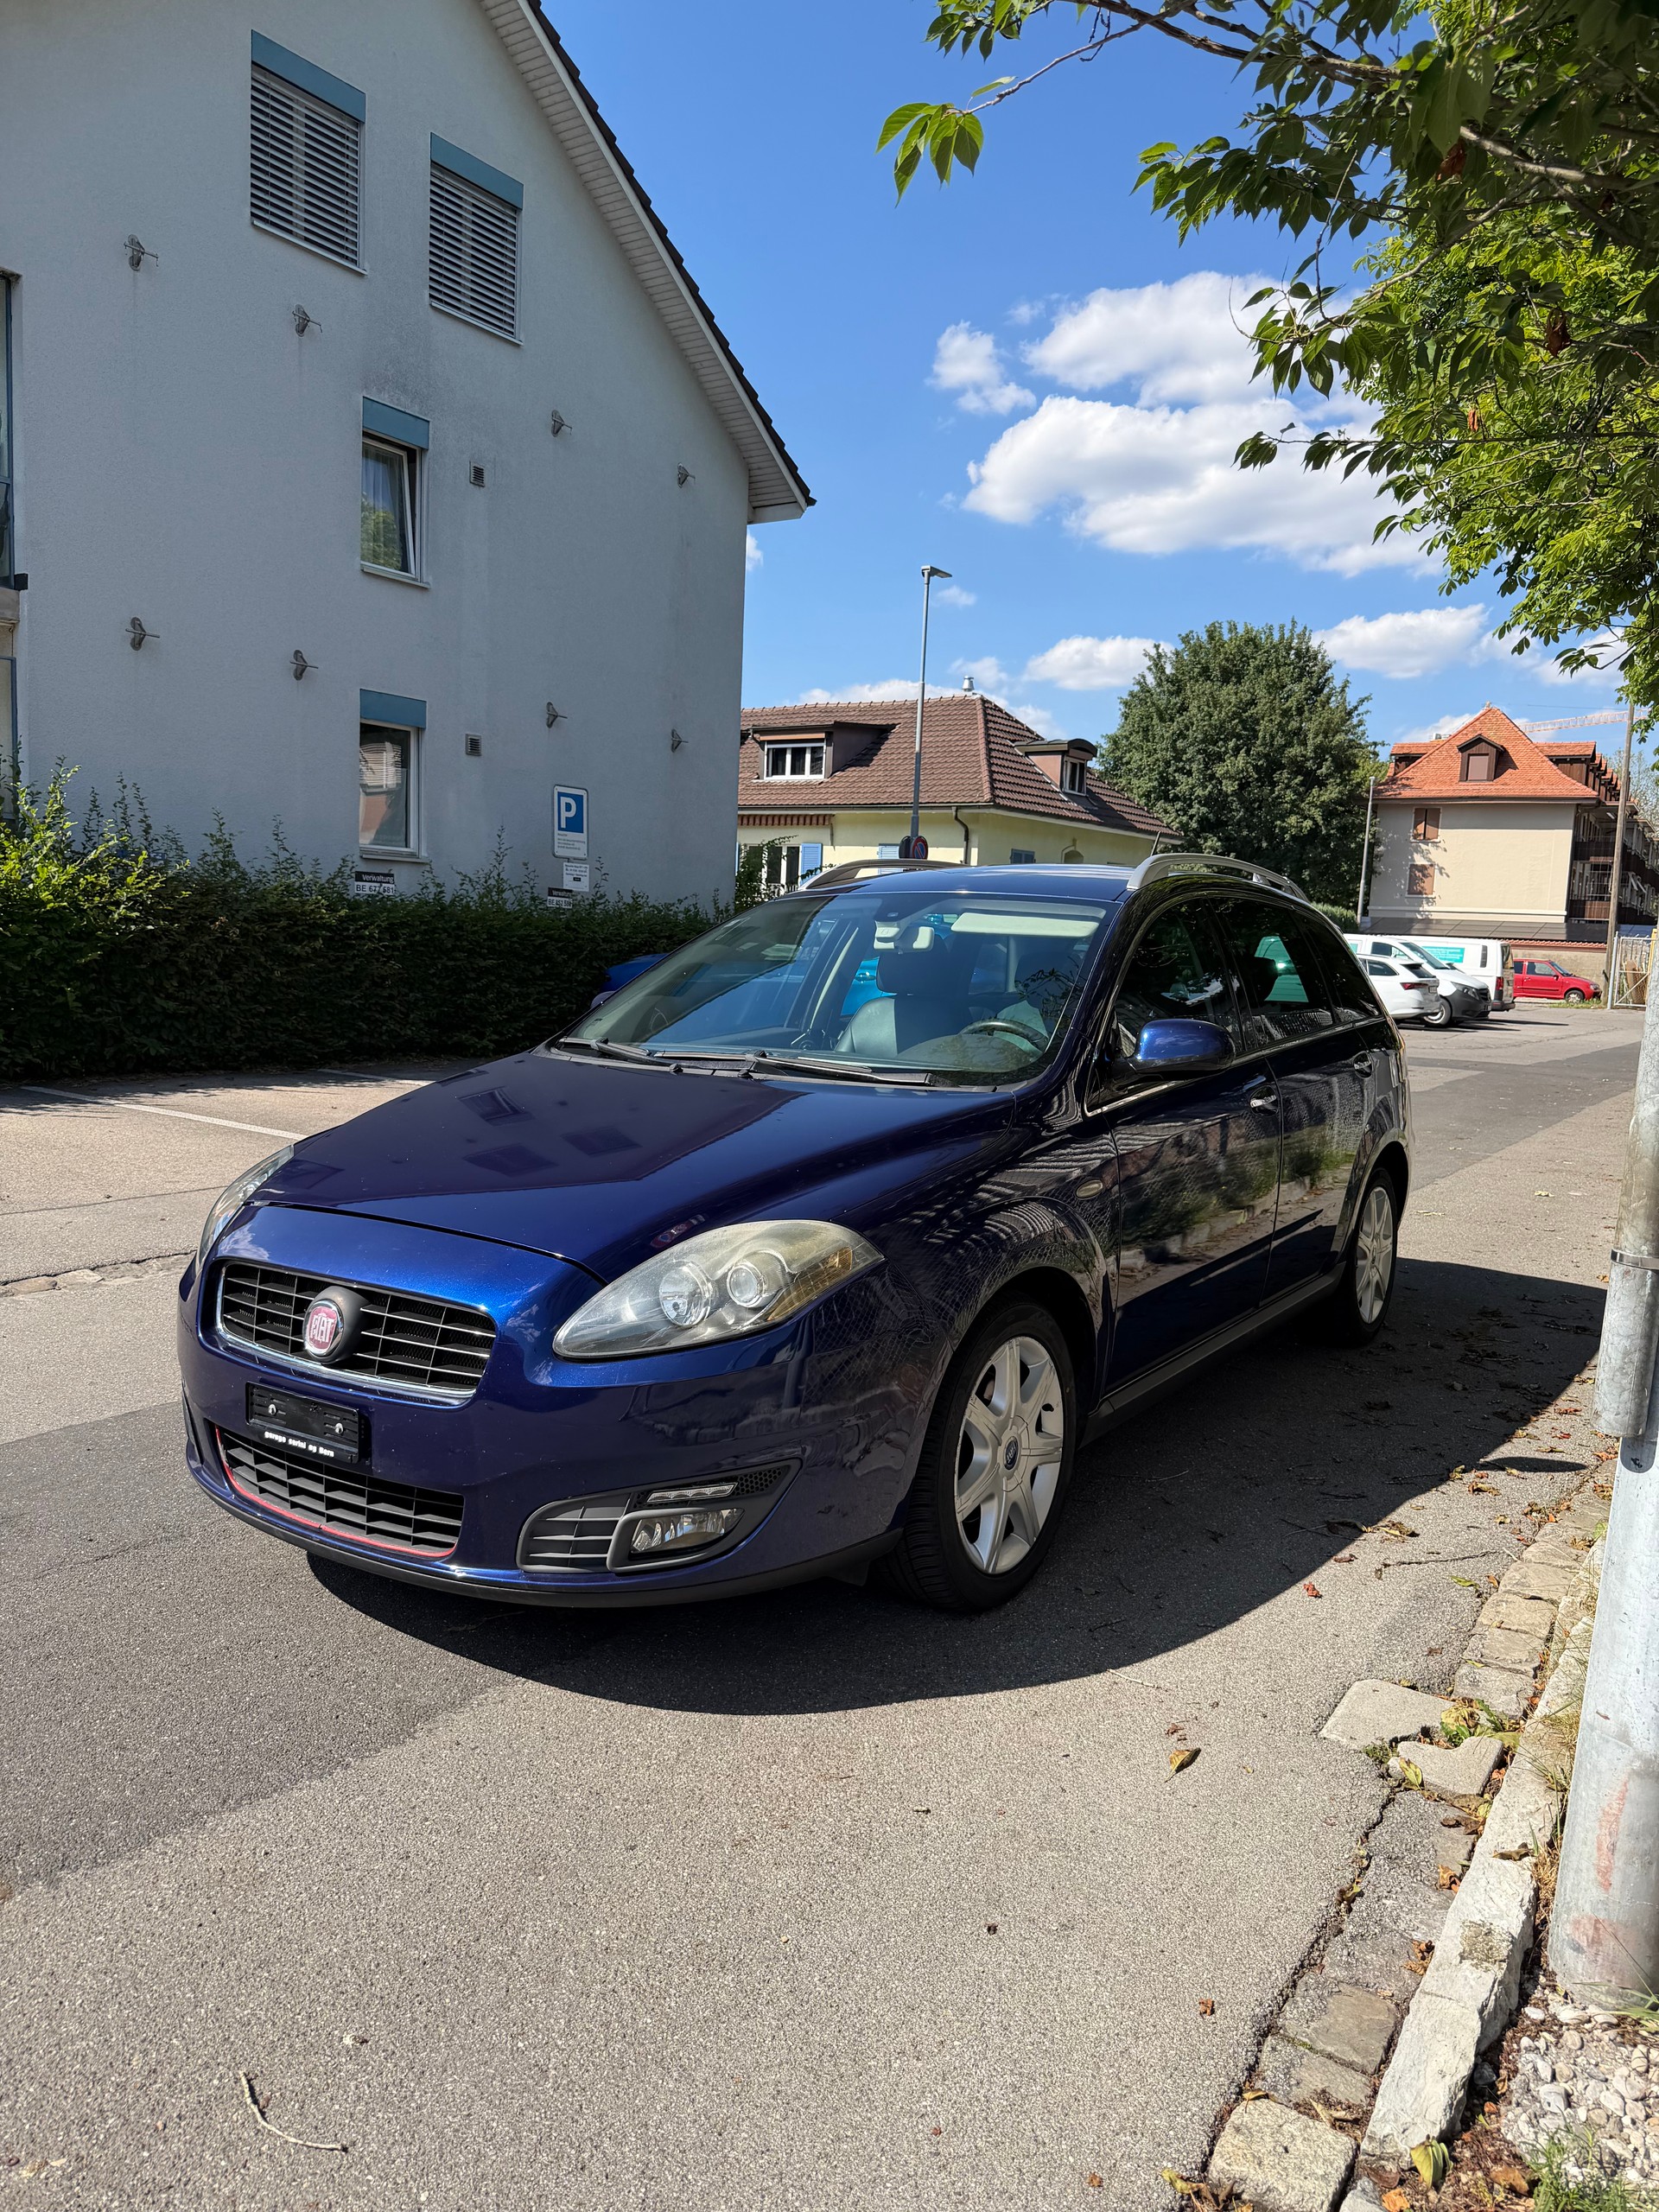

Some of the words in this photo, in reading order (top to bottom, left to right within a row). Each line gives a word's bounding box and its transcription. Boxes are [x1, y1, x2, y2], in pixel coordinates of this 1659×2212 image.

[560, 796, 577, 829] P
[362, 874, 394, 884] Verwaltung
[356, 884, 367, 893] BE
[382, 886, 394, 894] 581
[309, 1314, 335, 1343] FIAT
[318, 1446, 334, 1458] Bern
